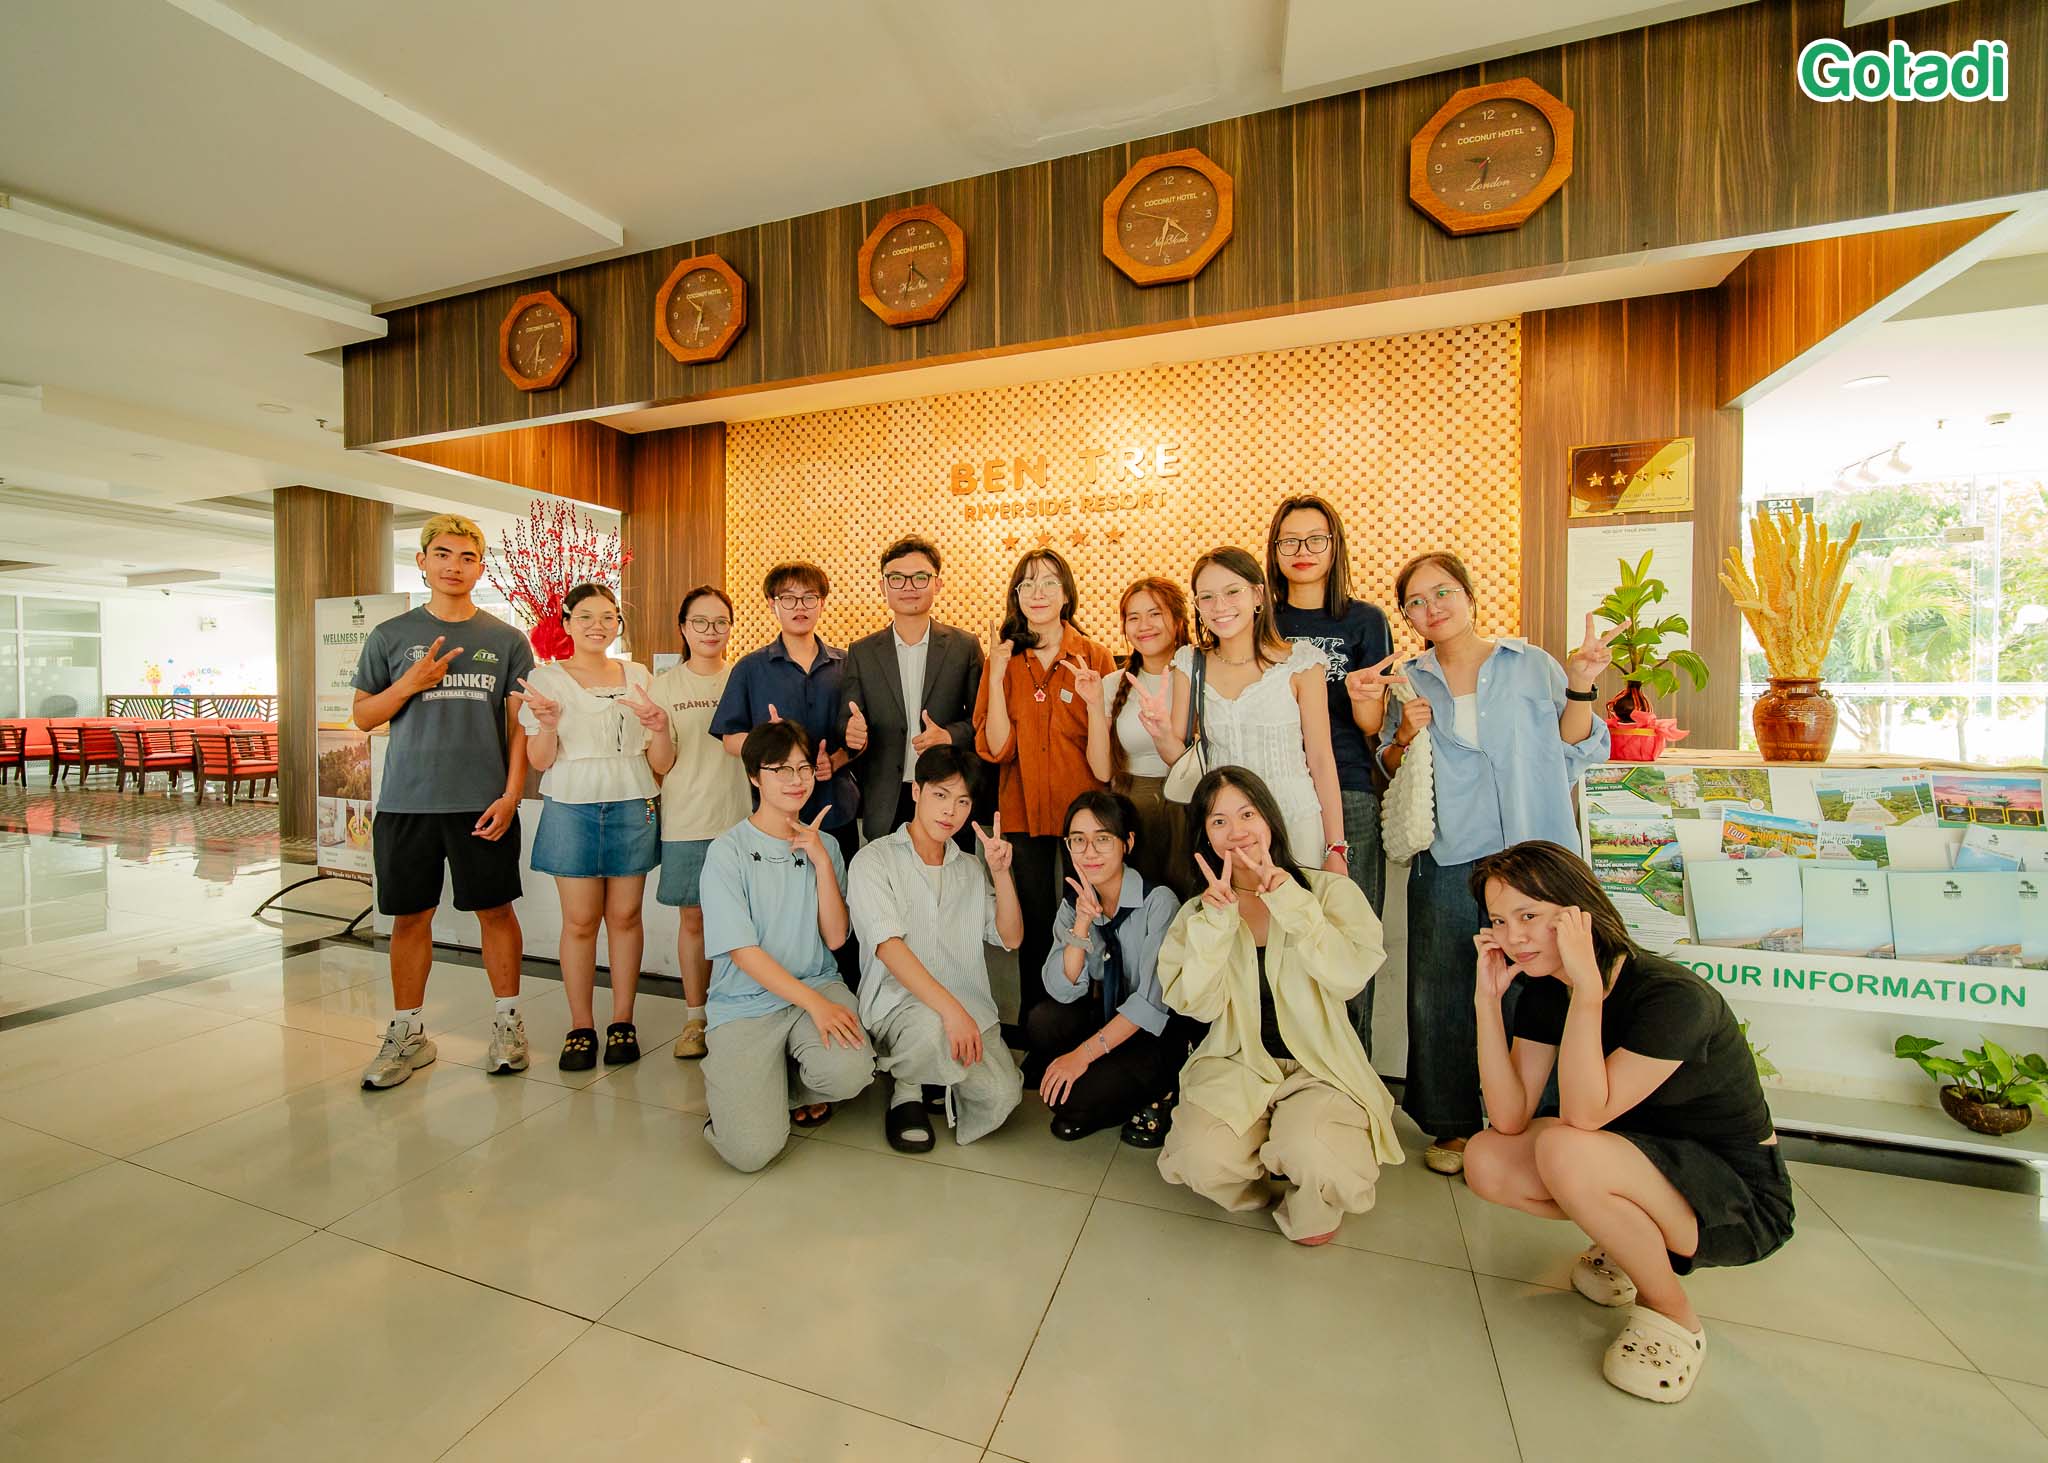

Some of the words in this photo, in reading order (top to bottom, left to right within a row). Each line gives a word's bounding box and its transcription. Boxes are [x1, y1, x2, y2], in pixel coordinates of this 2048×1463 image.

[1481, 109, 1496, 121] 12
[1457, 132, 1497, 145] COCONUT
[1498, 127, 1525, 138] HOTEL
[1534, 146, 1544, 157] 3
[1434, 163, 1444, 174] 9
[1163, 176, 1175, 186] 12
[1465, 176, 1511, 193] London
[1144, 195, 1176, 208] COCONUT
[1176, 192, 1198, 202] HOTEL
[1483, 200, 1492, 210] 6
[1205, 209, 1213, 218] 3
[906, 227, 916, 237] 12
[1125, 222, 1133, 231] 9
[892, 245, 918, 257] COCONUT
[918, 242, 936, 251] HOTEL
[1163, 255, 1171, 264] 6
[950, 454, 1048, 497] BEN
[1078, 443, 1181, 484] TRE
[964, 497, 1072, 522] RIVERSIDE
[1079, 490, 1168, 513] RESORT
[323, 632, 358, 645] WELLNESS
[443, 672, 497, 692] DINKER
[1727, 824, 1749, 841] Tour
[1673, 960, 1762, 986] OUR
[1772, 966, 2027, 1008] INFORMATION
